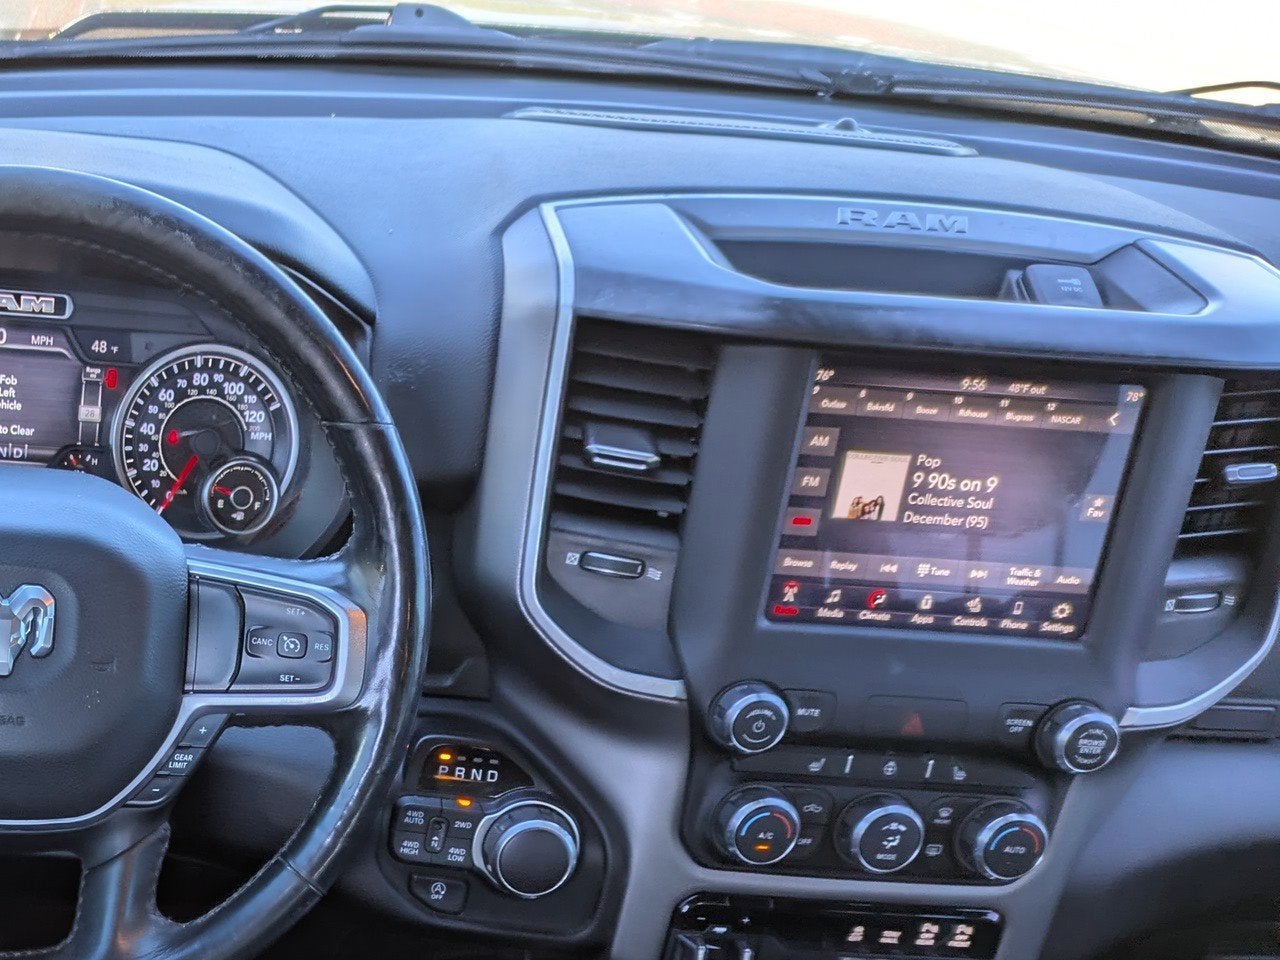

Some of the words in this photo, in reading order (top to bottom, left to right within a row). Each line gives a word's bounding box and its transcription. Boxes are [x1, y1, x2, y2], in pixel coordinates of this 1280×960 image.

[837, 206, 969, 234] RAM
[31, 335, 54, 346] MPH
[91, 340, 108, 354] 48
[0, 374, 18, 386] Fob
[177, 379, 188, 388] 70
[193, 373, 209, 387] 80
[213, 374, 224, 383] 90
[223, 382, 245, 395] 100
[961, 379, 988, 391] 9:56
[1030, 385, 1047, 394] out
[158, 388, 175, 402] 60
[244, 395, 257, 404] 110
[953, 396, 964, 405] 10
[999, 399, 1010, 408] 11
[1046, 402, 1057, 411] 12
[148, 405, 159, 414] 50
[243, 410, 265, 424] 120
[1050, 415, 1082, 425] NASCAR
[0, 424, 9, 435] to
[10, 424, 35, 437] Clear
[139, 423, 155, 436] 40
[250, 432, 272, 441] MPH
[809, 434, 830, 447] AM
[14, 448, 22, 459] D
[138, 444, 149, 452] 30
[142, 459, 159, 471] 20
[917, 455, 942, 469] Pop
[151, 479, 160, 488] 10
[802, 477, 821, 488] FM
[912, 472, 925, 488] 9
[928, 473, 956, 490] 90s
[960, 479, 981, 492] on
[985, 476, 999, 493] 9
[254, 502, 261, 510] F
[908, 493, 964, 508] Collective
[967, 497, 994, 510] Soul
[1087, 508, 1105, 518] Fav
[903, 511, 963, 527] December
[965, 516, 989, 530] (95)
[782, 556, 813, 568] Browse
[830, 560, 858, 572] Replay
[930, 566, 951, 577] Tune
[1009, 567, 1034, 577] Traffic
[1006, 577, 1040, 587] Weather
[1056, 575, 1081, 585] Audio
[817, 606, 844, 618] Media
[858, 610, 891, 621] Climate
[911, 613, 935, 625] Apps
[953, 615, 988, 627] Controls
[1000, 618, 1028, 630] Phone
[1040, 622, 1076, 635] Settings
[251, 636, 273, 647] CANC
[314, 643, 329, 651] RES
[796, 707, 821, 717] MUTE
[174, 753, 193, 762] GEAR
[169, 761, 188, 769] LIMIT
[438, 765, 448, 776] P
[454, 767, 466, 779] R
[470, 769, 483, 781] N
[487, 770, 498, 782] D
[406, 810, 424, 818] 4WD
[454, 820, 472, 829] 2WD
[758, 831, 774, 840] A/C
[402, 840, 420, 849] 4WD
[1003, 846, 1026, 854] AUTO
[400, 847, 419, 856] HIGH
[448, 847, 466, 855] 4WD
[447, 854, 465, 862] LOW
